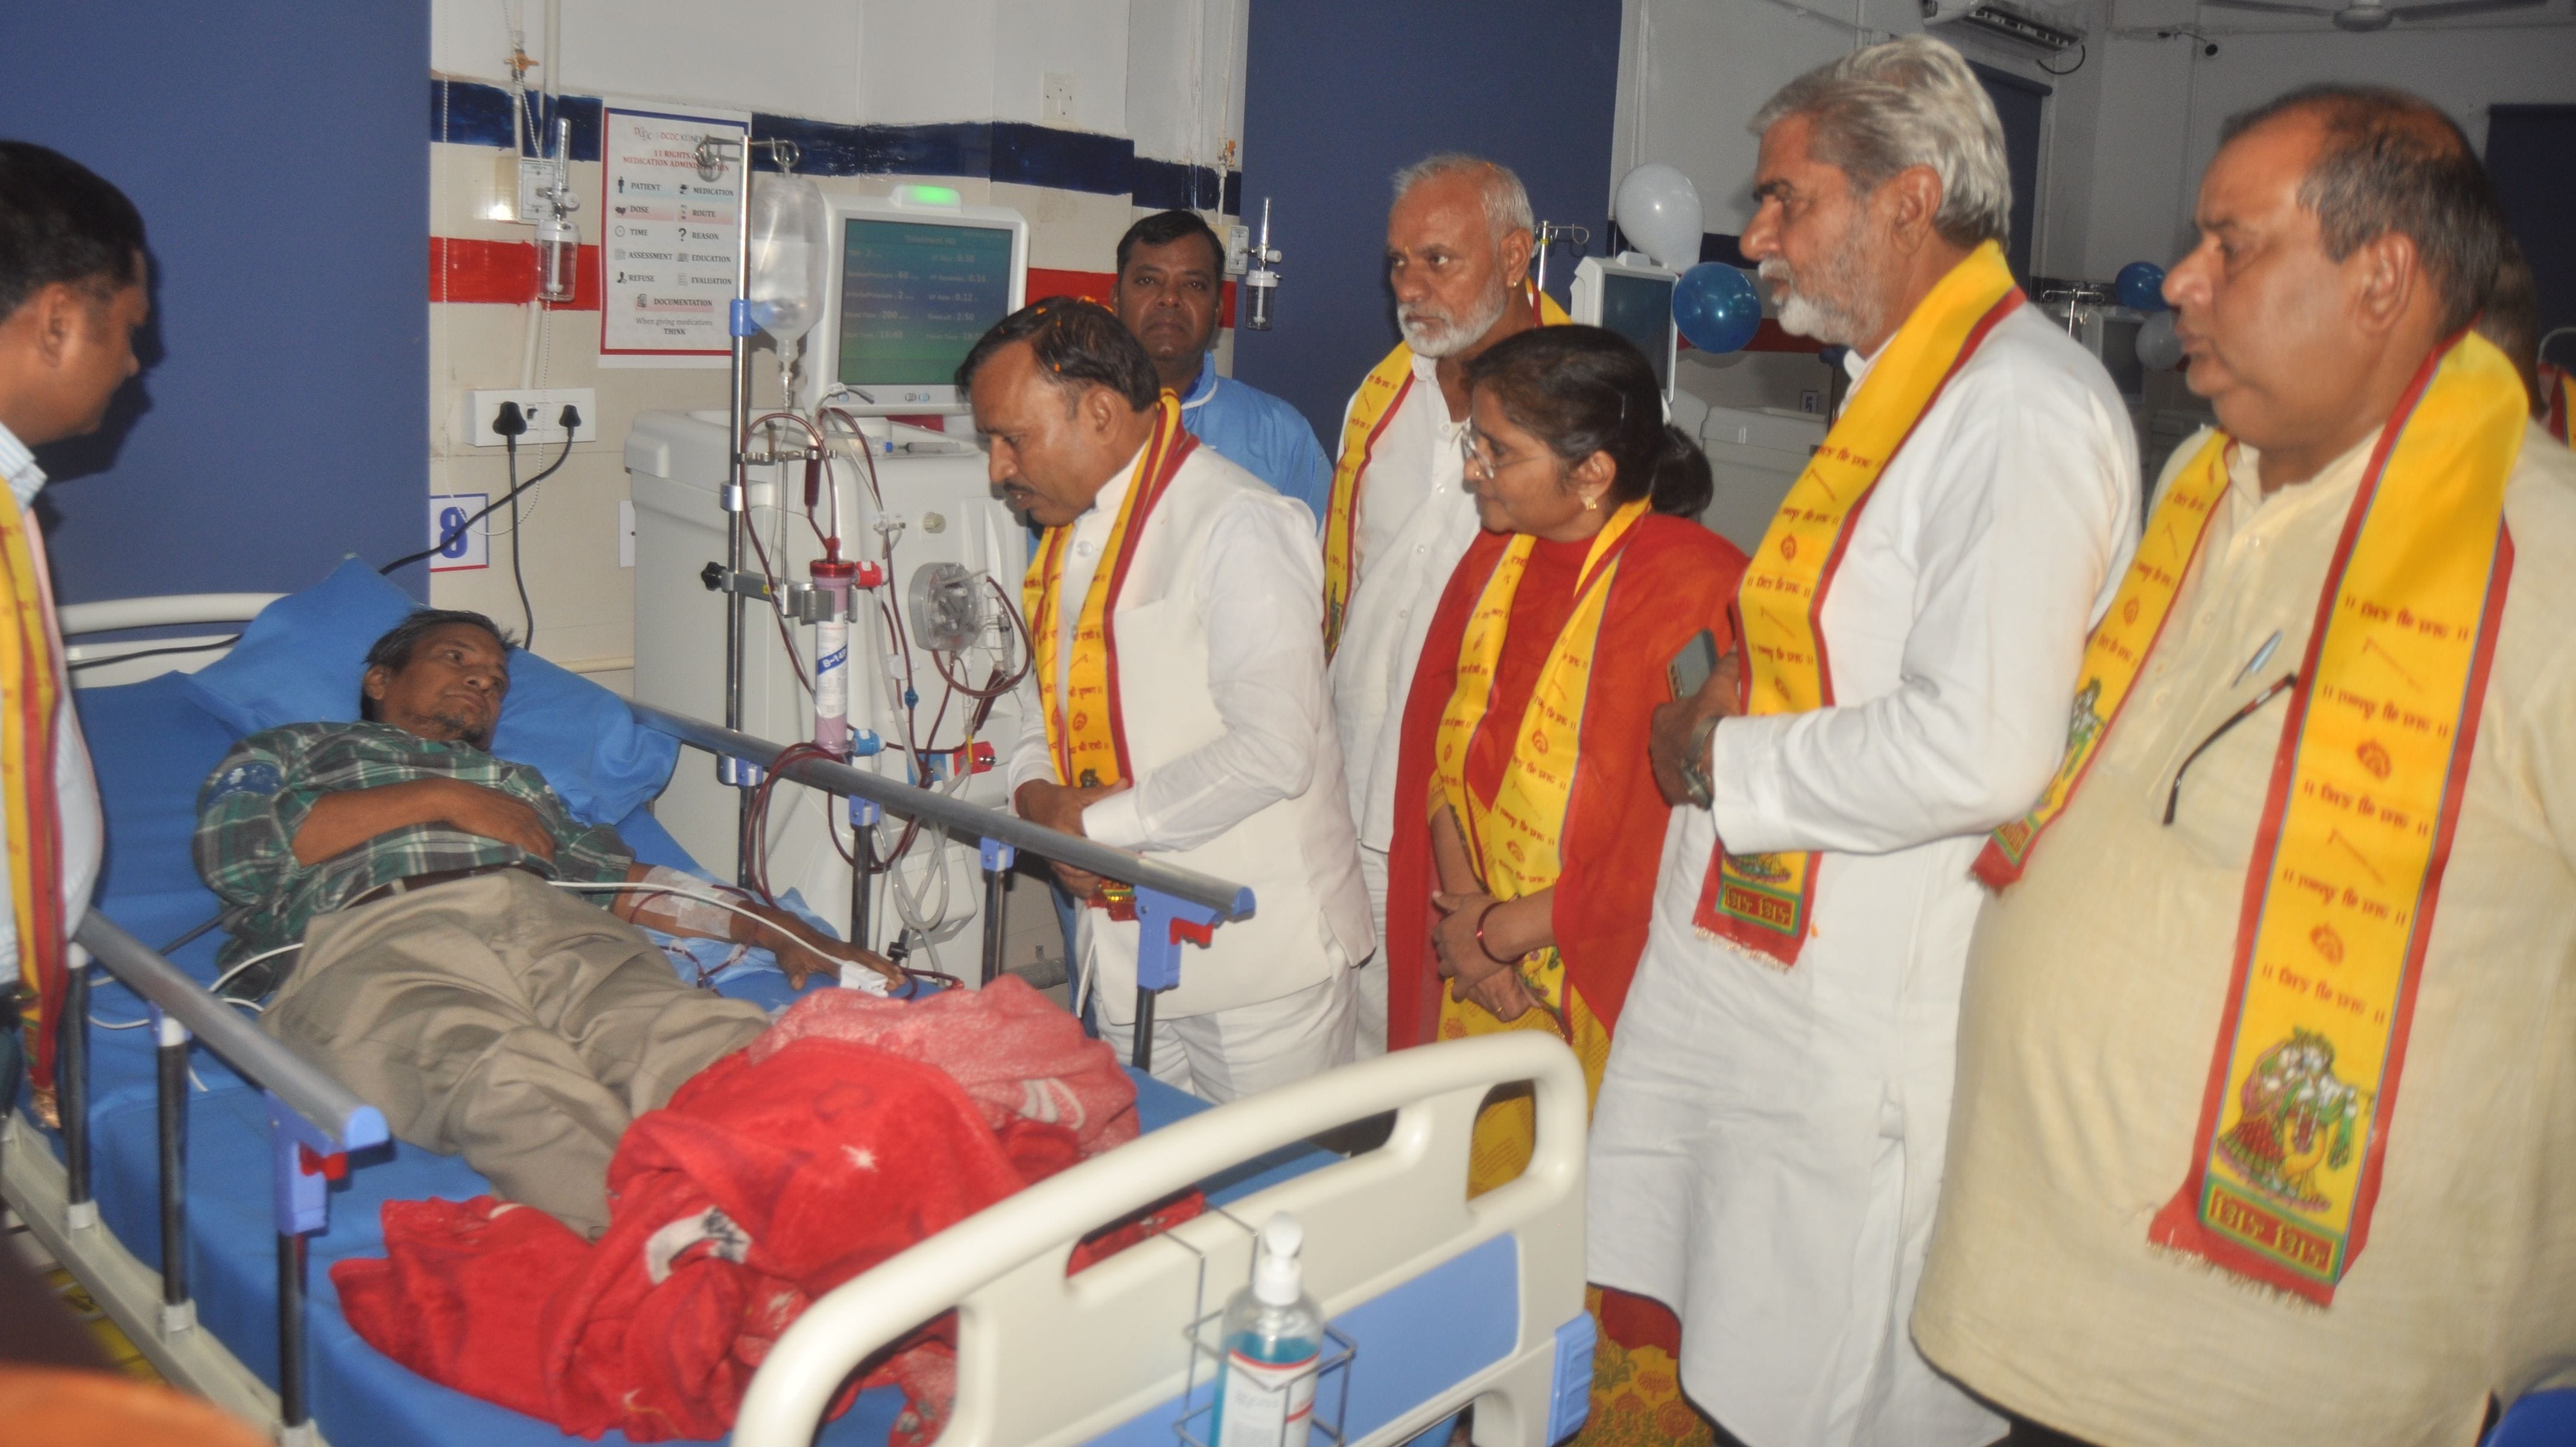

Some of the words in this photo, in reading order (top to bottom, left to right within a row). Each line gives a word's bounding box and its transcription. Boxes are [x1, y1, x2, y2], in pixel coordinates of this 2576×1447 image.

[664, 151, 690, 159] RIGHTS
[623, 156, 668, 167] MEDICATION
[631, 182, 661, 191] PATIENT
[694, 186, 734, 196] MEDICATION
[628, 252, 673, 260] ASSESSMENT
[654, 298, 712, 307] DOCUMENTATION
[440, 506, 468, 559] 8
